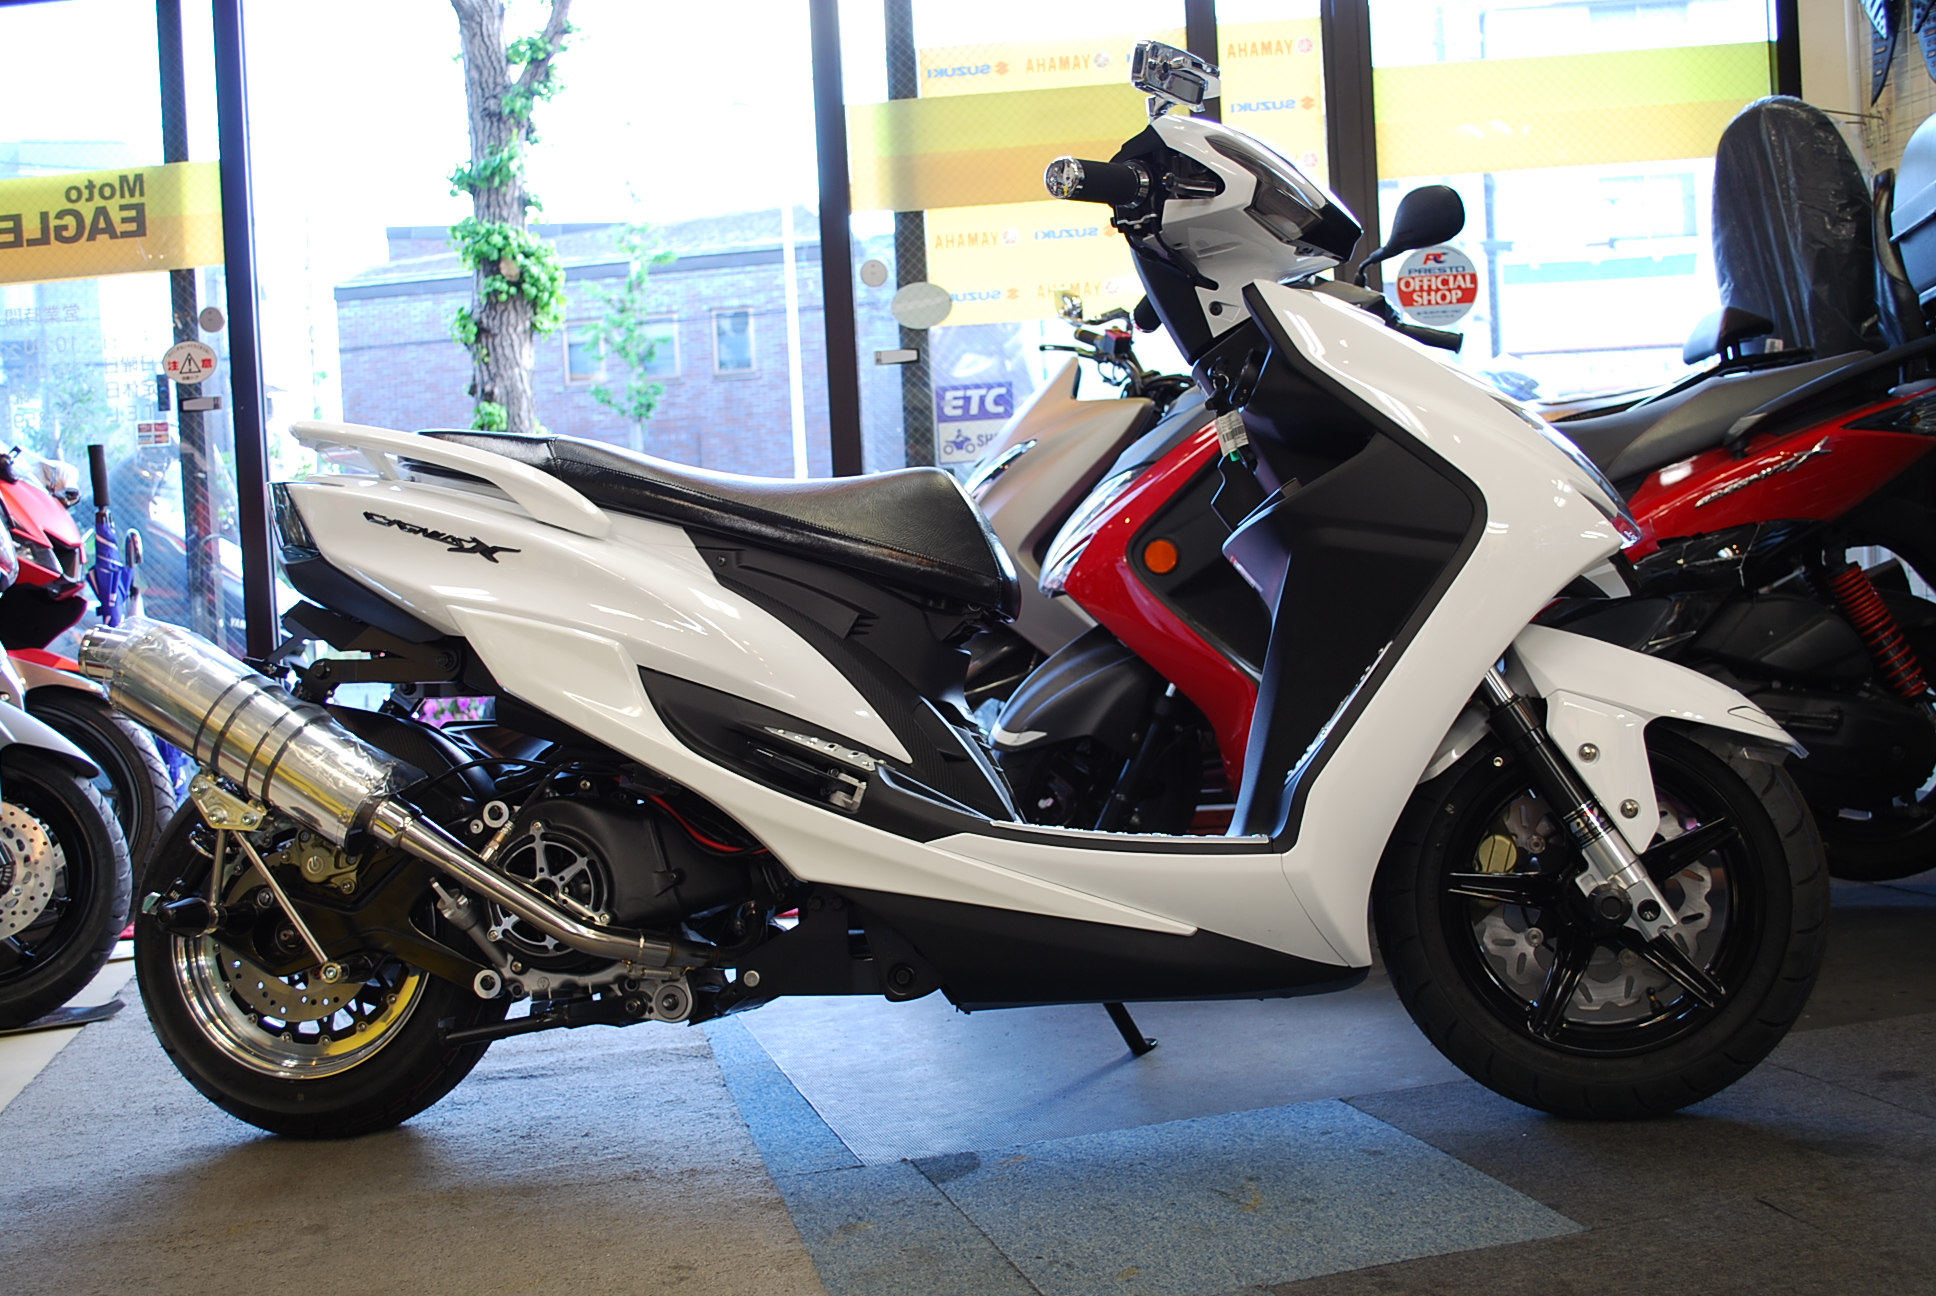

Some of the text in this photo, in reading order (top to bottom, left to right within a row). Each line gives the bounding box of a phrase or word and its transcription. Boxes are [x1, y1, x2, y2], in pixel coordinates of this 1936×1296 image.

[1408, 266, 1466, 275] PRESTO
[1399, 274, 1475, 292] OFFICIAL
[1412, 290, 1463, 306] SHOP
[943, 387, 1007, 417] ETC
[976, 432, 999, 448] SH
